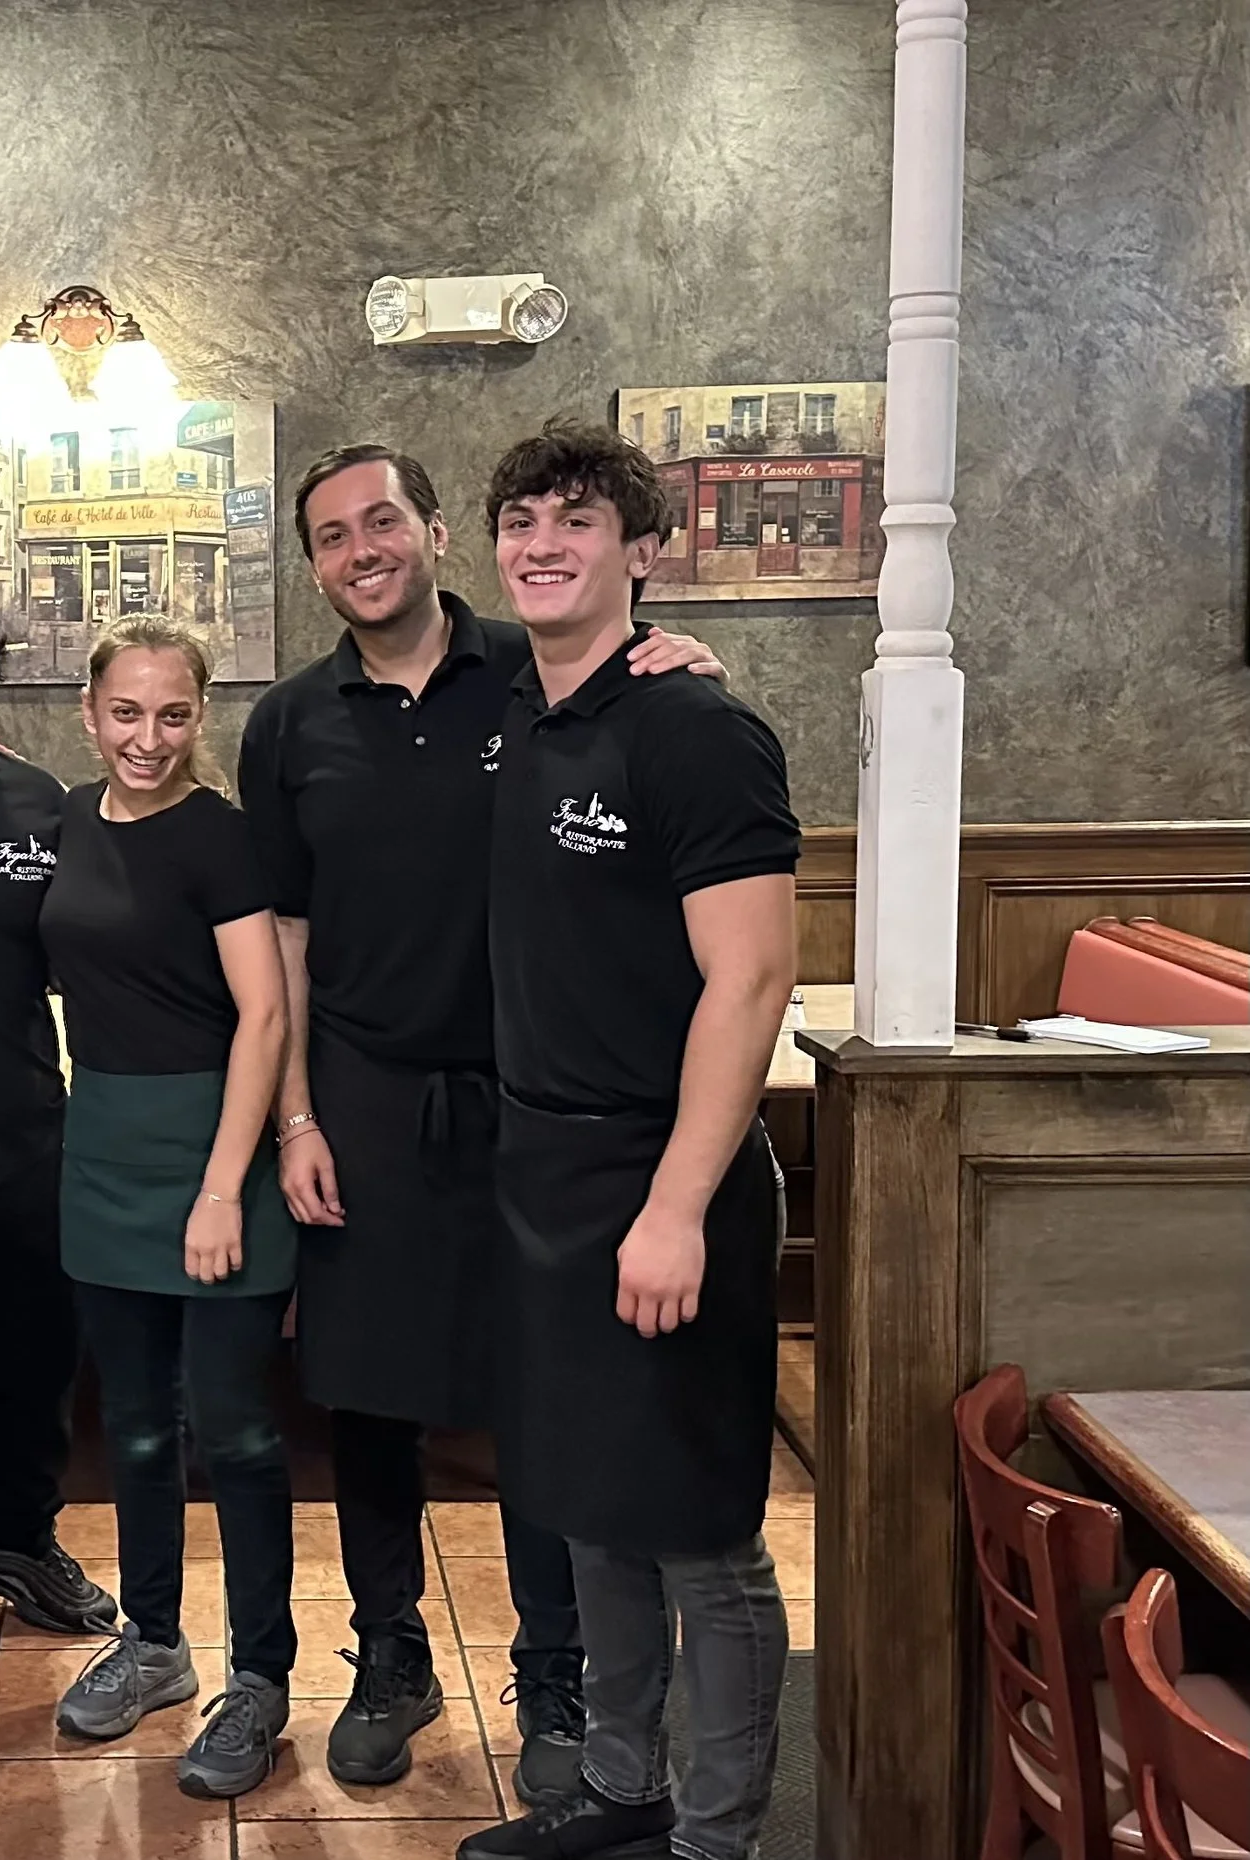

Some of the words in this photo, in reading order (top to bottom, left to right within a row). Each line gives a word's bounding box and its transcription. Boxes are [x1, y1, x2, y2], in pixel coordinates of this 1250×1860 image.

[738, 463, 756, 477] La
[760, 462, 819, 477] Casserole
[33, 509, 56, 526] Café
[61, 509, 72, 523] de
[116, 505, 128, 520] de
[130, 504, 157, 520] Ville
[31, 555, 81, 566] RESTAURANT
[565, 830, 627, 850] RISTORANTE
